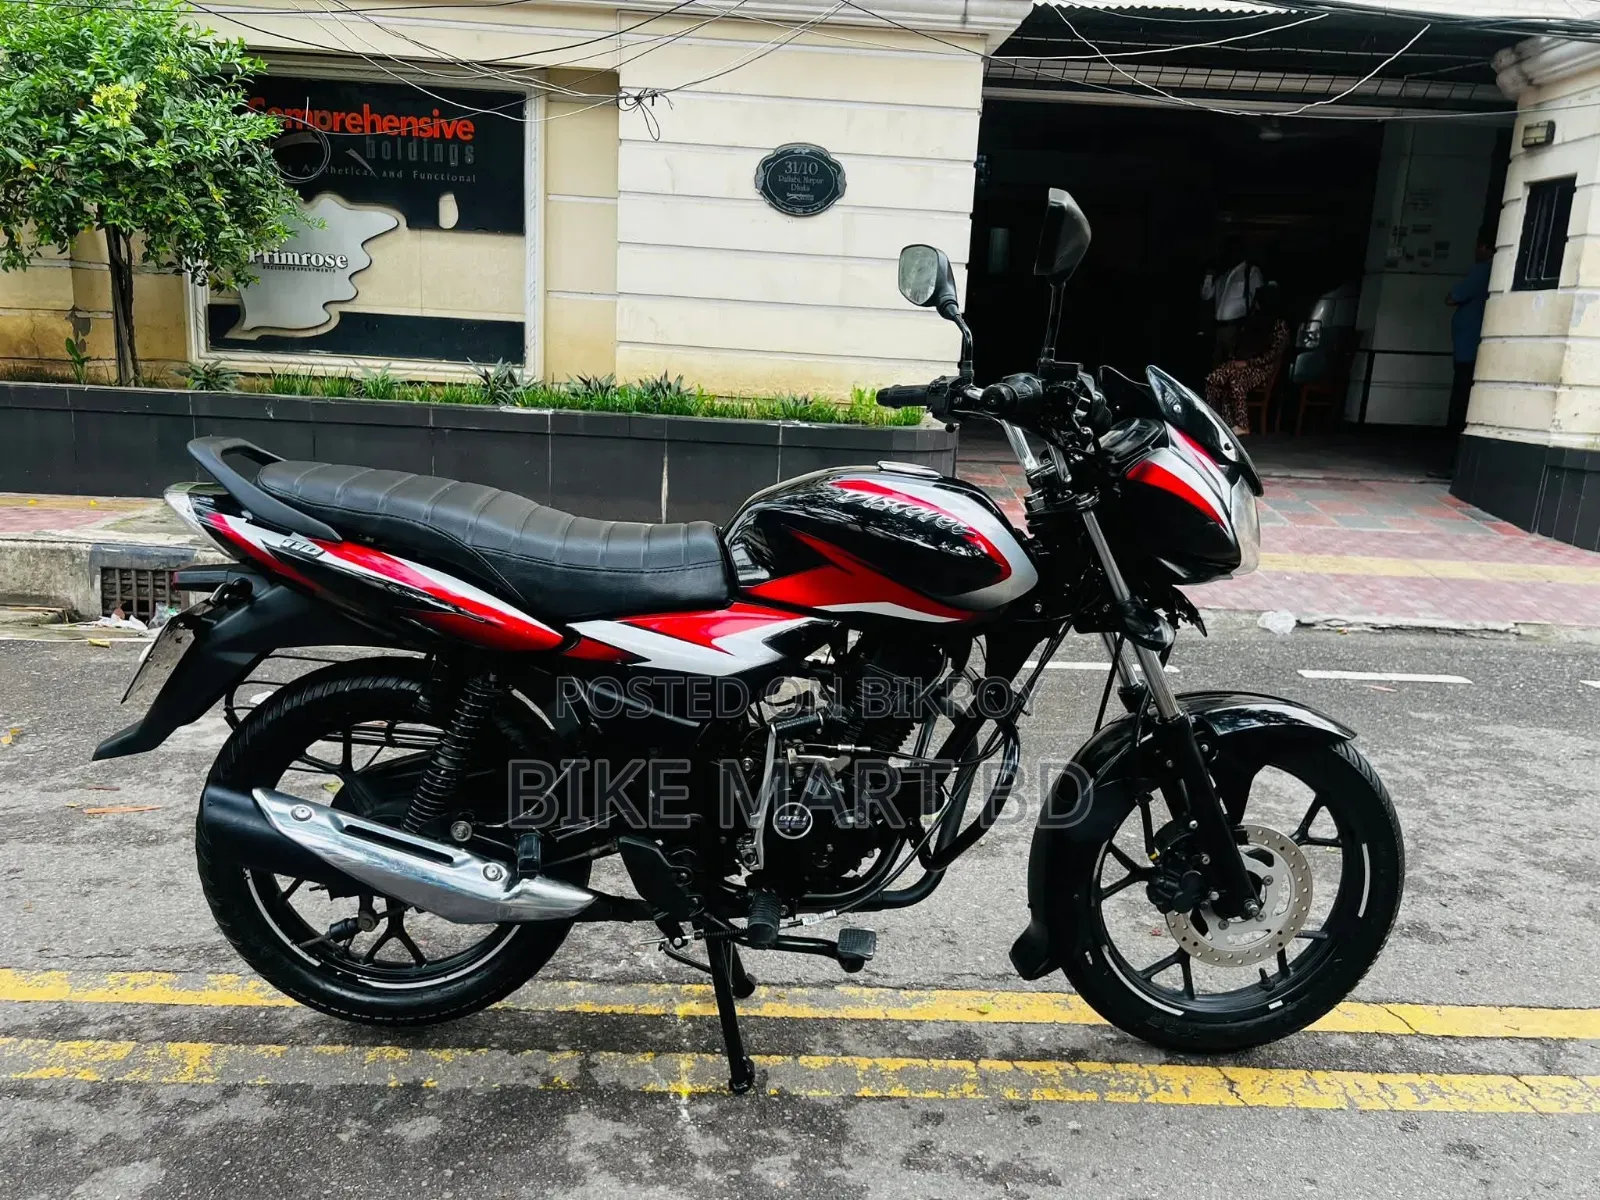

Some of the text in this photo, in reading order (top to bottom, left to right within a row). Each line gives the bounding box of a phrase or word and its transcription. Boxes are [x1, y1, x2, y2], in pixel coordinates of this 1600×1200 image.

[366, 136, 474, 166] holdings
[784, 161, 819, 174] 31/10
[413, 170, 476, 183] Functional
[248, 249, 349, 269] Primrose
